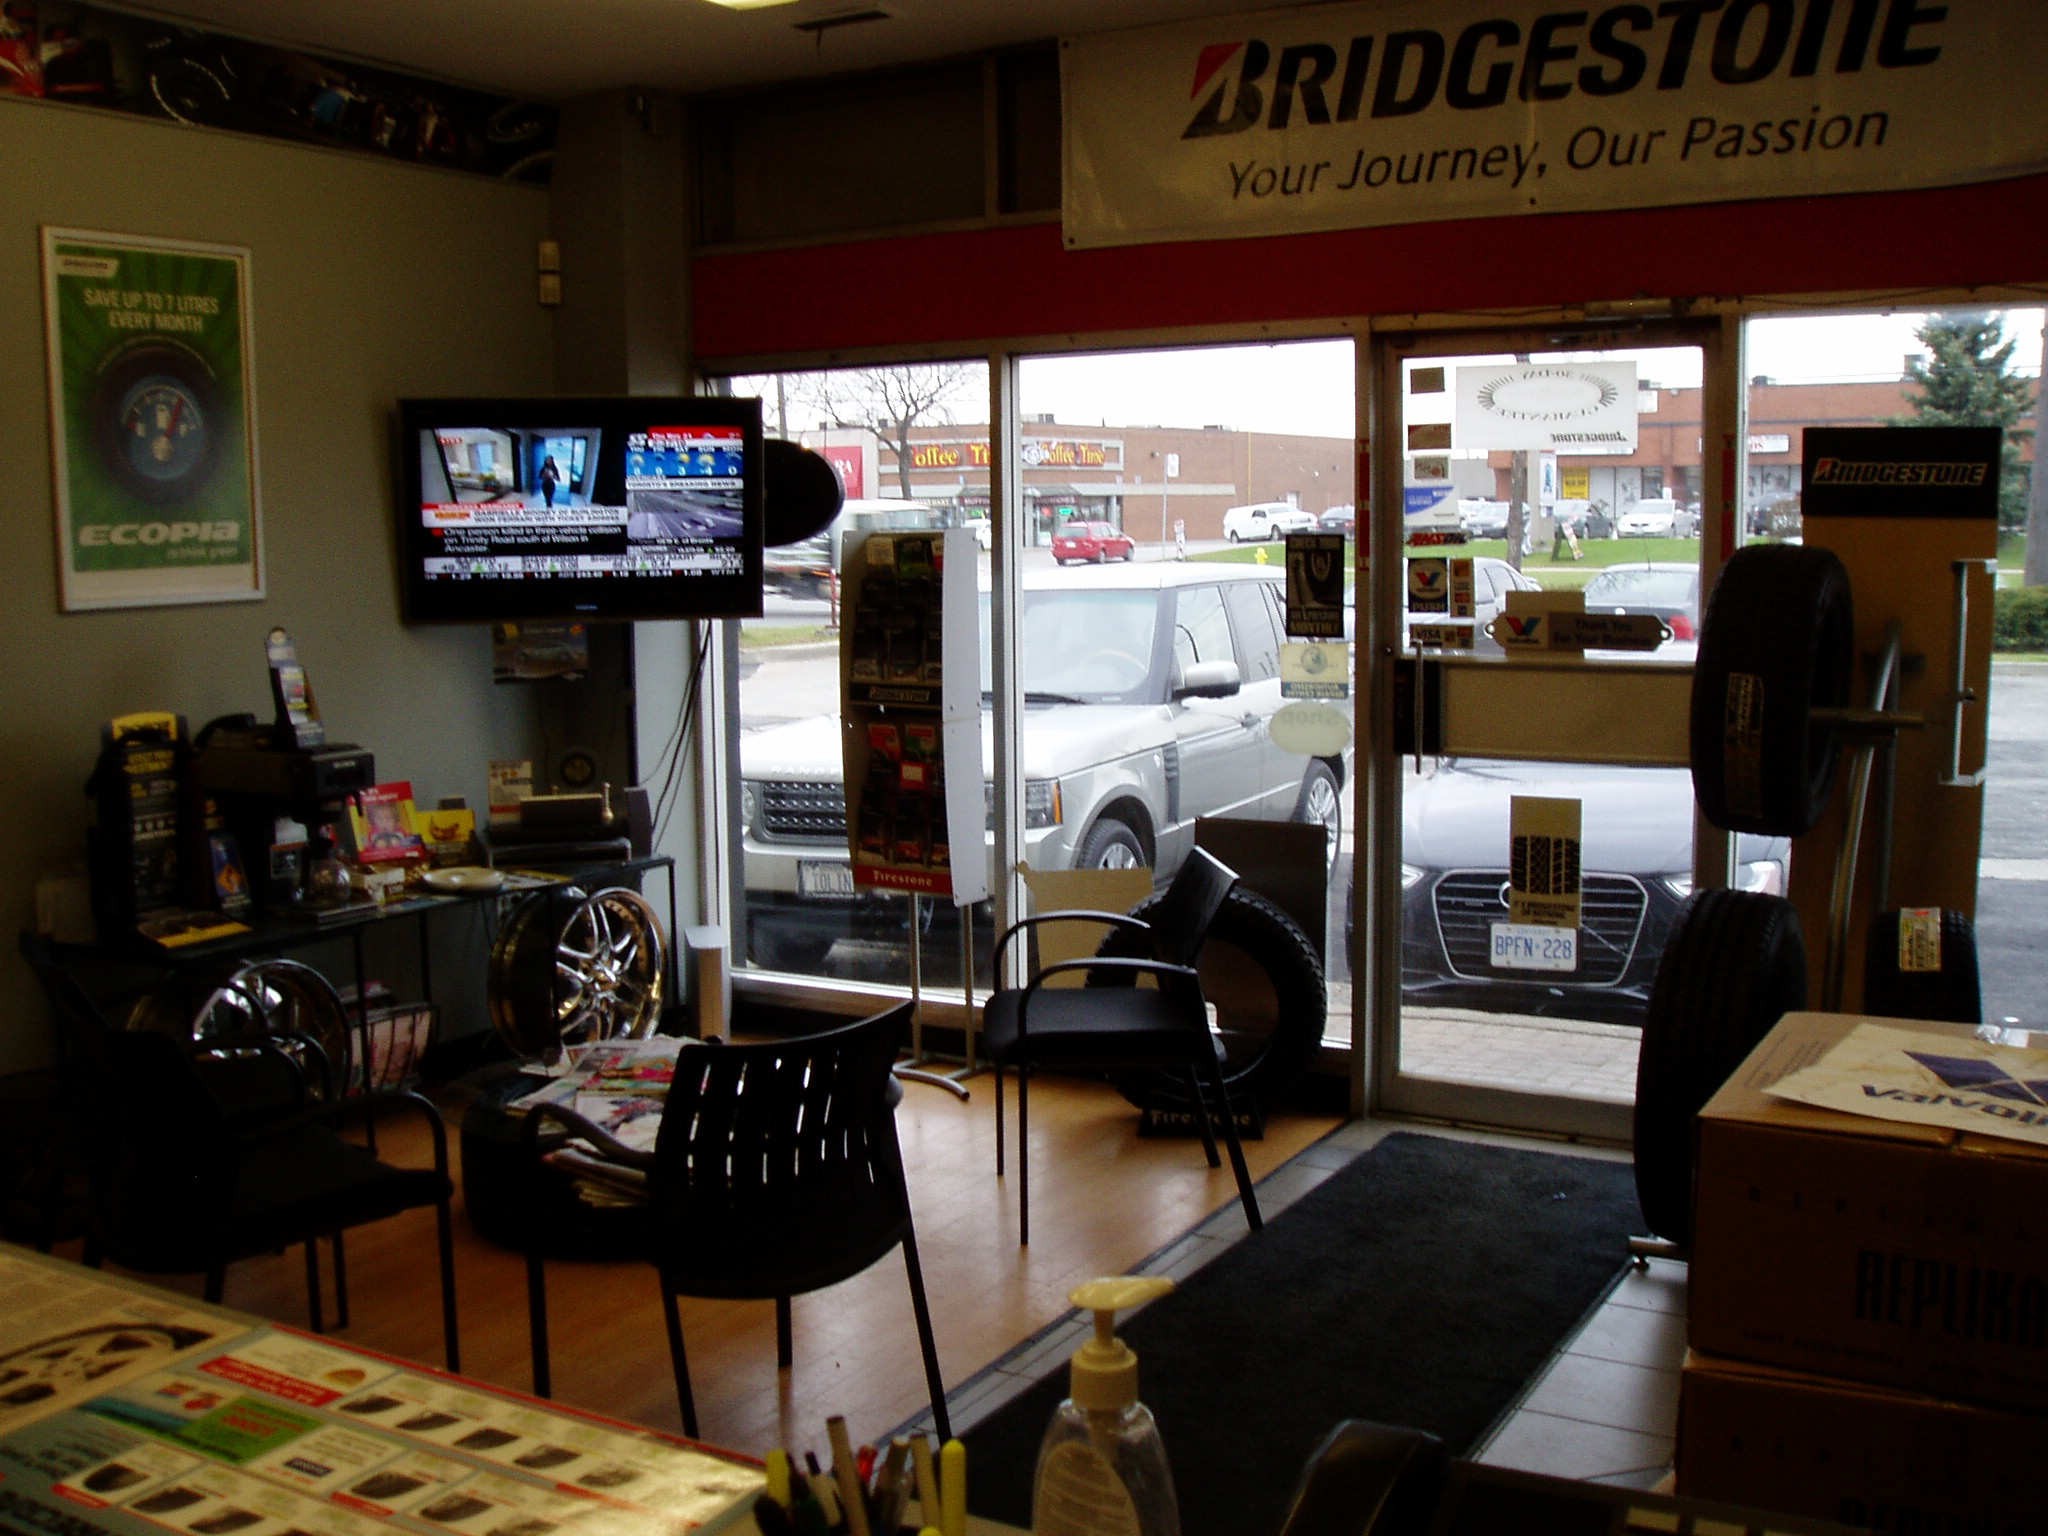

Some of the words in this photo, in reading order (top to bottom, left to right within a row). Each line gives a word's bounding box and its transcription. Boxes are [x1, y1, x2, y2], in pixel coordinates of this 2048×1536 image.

[1181, 0, 1948, 140] BRIDGESTONE
[1229, 161, 1330, 199] Your
[1337, 142, 1547, 193] Journey,
[1567, 126, 1666, 169] Our
[1681, 106, 1888, 160] Passion
[122, 291, 142, 309] UP
[145, 292, 162, 310] TO
[109, 309, 149, 328] EVERY
[154, 312, 203, 331] MONTH
[912, 444, 959, 466] offee
[1078, 444, 1105, 464] Time
[1811, 457, 1990, 485] BRIDGESTONE
[873, 869, 933, 887] Firestone
[1855, 1250, 2048, 1348] REPLIKA
